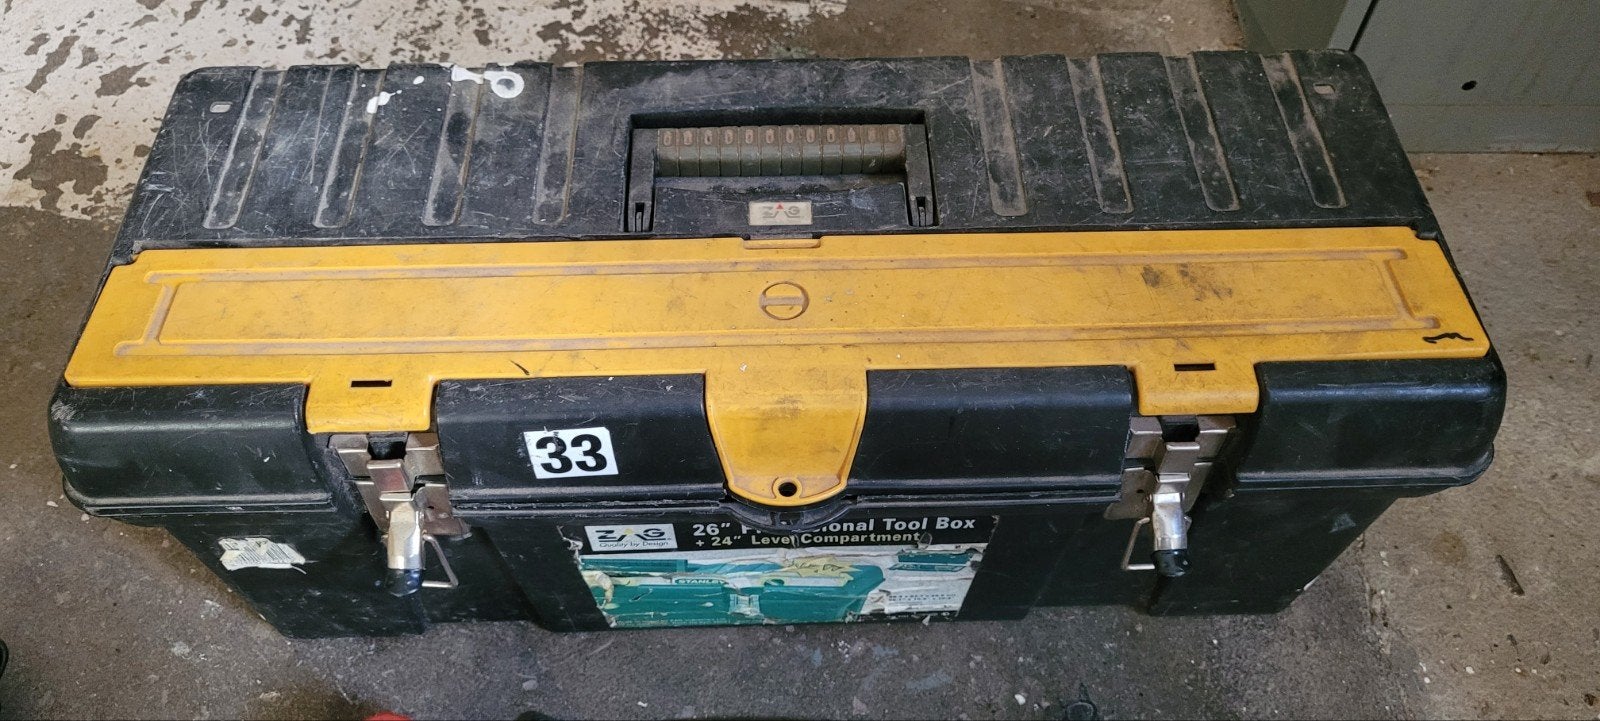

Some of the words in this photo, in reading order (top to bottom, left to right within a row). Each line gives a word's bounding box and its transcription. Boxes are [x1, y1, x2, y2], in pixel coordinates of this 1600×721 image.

[535, 433, 607, 474] 33
[883, 517, 928, 531] Tool
[935, 516, 976, 530] Box
[595, 528, 667, 542] ZAG
[696, 540, 704, 548] +
[800, 533, 920, 545] Compartment
[600, 542, 627, 550] Quality
